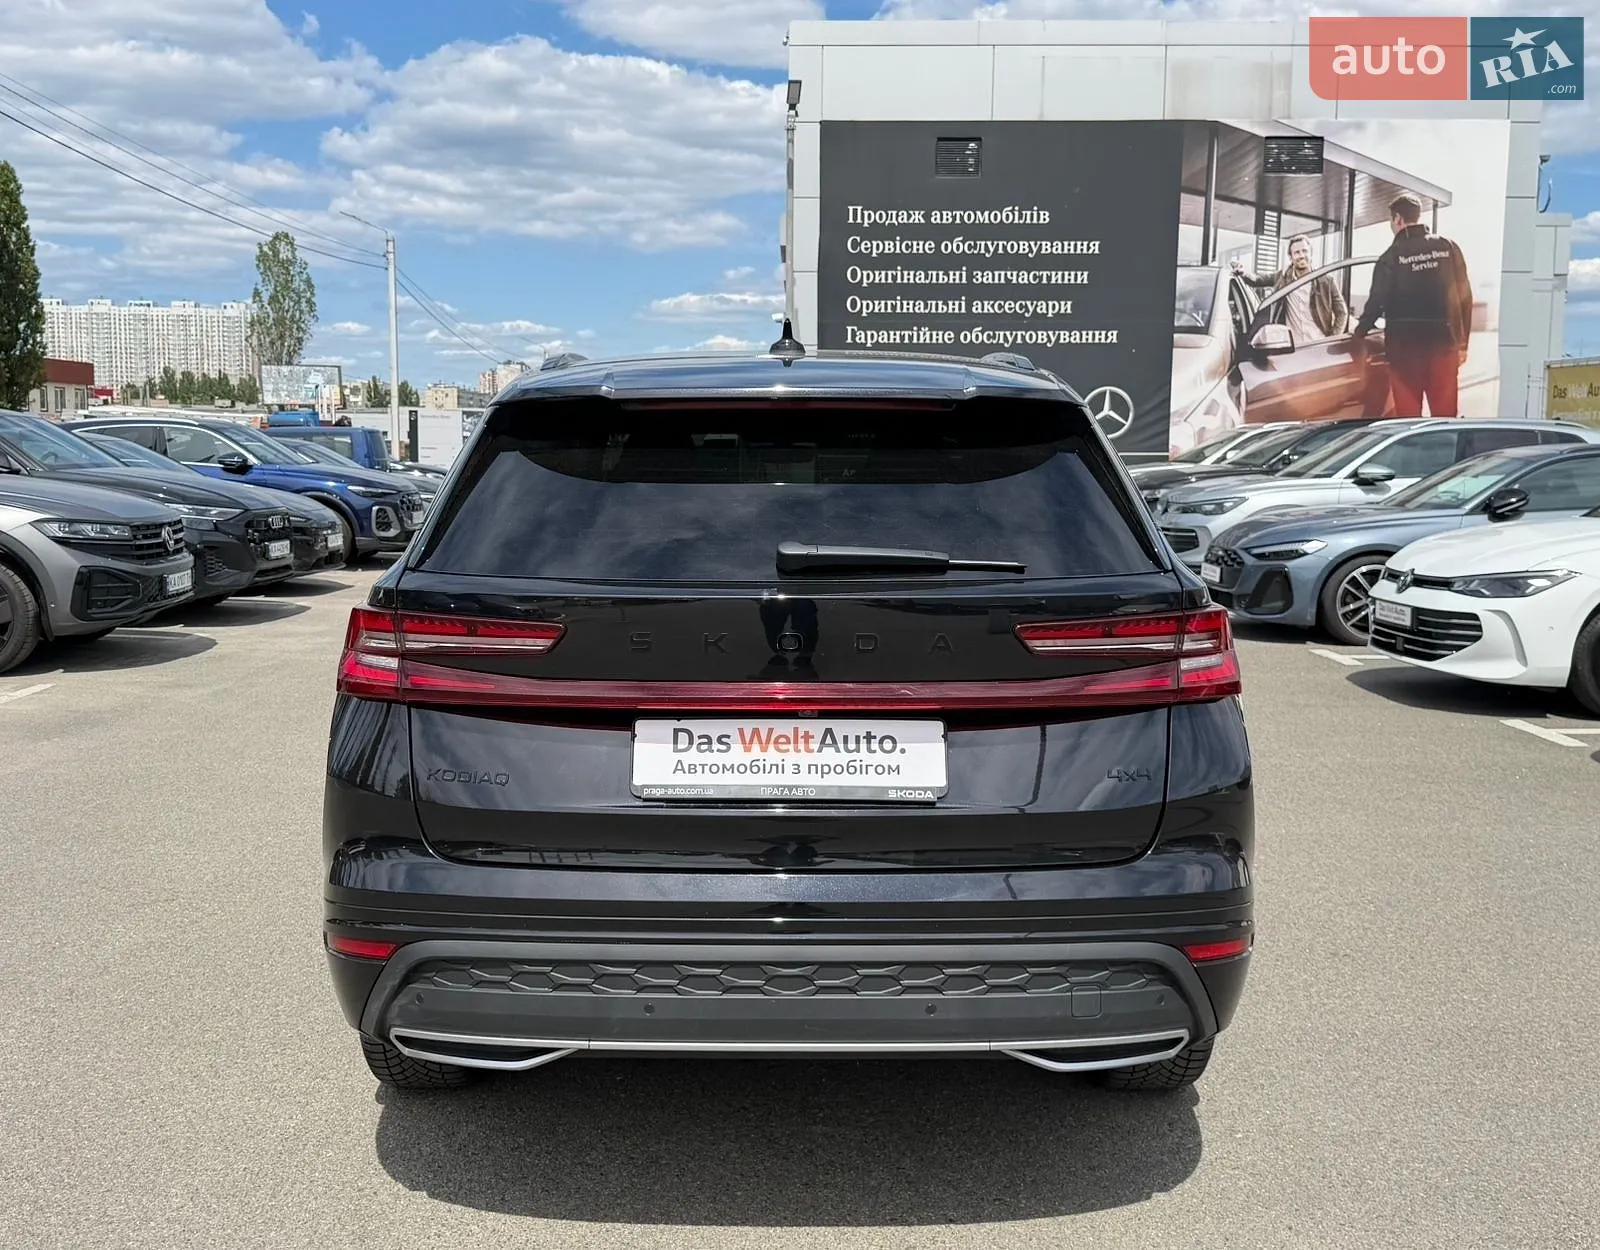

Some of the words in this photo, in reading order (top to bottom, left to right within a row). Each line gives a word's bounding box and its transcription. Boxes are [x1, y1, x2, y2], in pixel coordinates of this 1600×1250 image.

[847, 205, 926, 228] Продаж
[930, 205, 1050, 225] автомобілів
[846, 235, 936, 258] Сервісне
[940, 236, 1101, 258] обслуговування
[846, 265, 968, 287] Оригінальні
[972, 269, 1089, 285] запчастини
[1411, 261, 1439, 272] Service
[846, 295, 967, 317] Оригінальні
[971, 299, 1073, 318] аксесуари
[845, 325, 955, 347] Гарантійне
[959, 326, 1119, 348] обслуговування
[630, 632, 955, 652] SKODA
[671, 727, 731, 754] Das
[737, 727, 906, 755] WeltAuto.
[427, 768, 510, 787] KODIAQ
[672, 759, 785, 775] Автомобілі
[791, 762, 801, 775] з
[807, 759, 901, 779] пробігом
[643, 786, 714, 797] praga-auto.com.ua
[760, 787, 789, 796] ПРАГА
[790, 787, 816, 796] АВТО
[888, 789, 934, 799] SKODA
